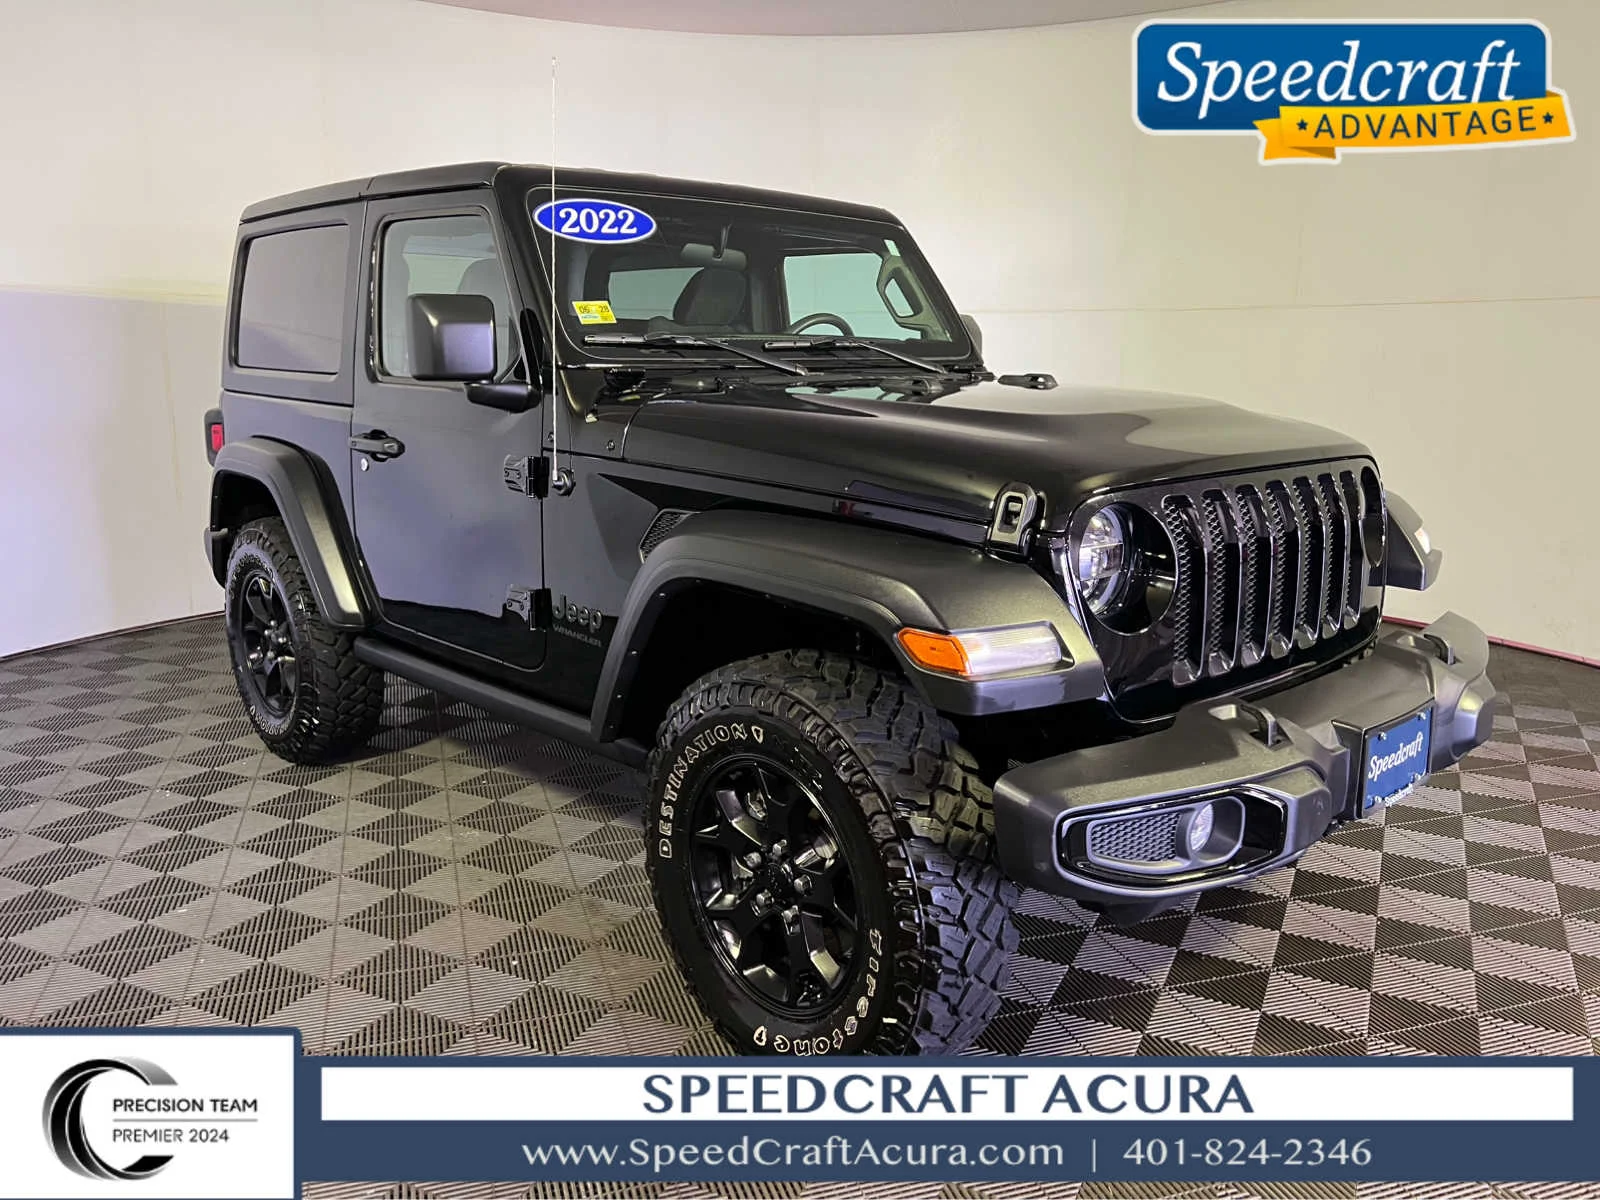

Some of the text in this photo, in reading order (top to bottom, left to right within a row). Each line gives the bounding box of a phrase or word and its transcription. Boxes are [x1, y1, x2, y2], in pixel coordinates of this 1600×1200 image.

[559, 208, 637, 234] 2022
[552, 594, 602, 633] Jeep
[1368, 731, 1424, 782] Speedcraft
[659, 722, 747, 858] DESTINATION
